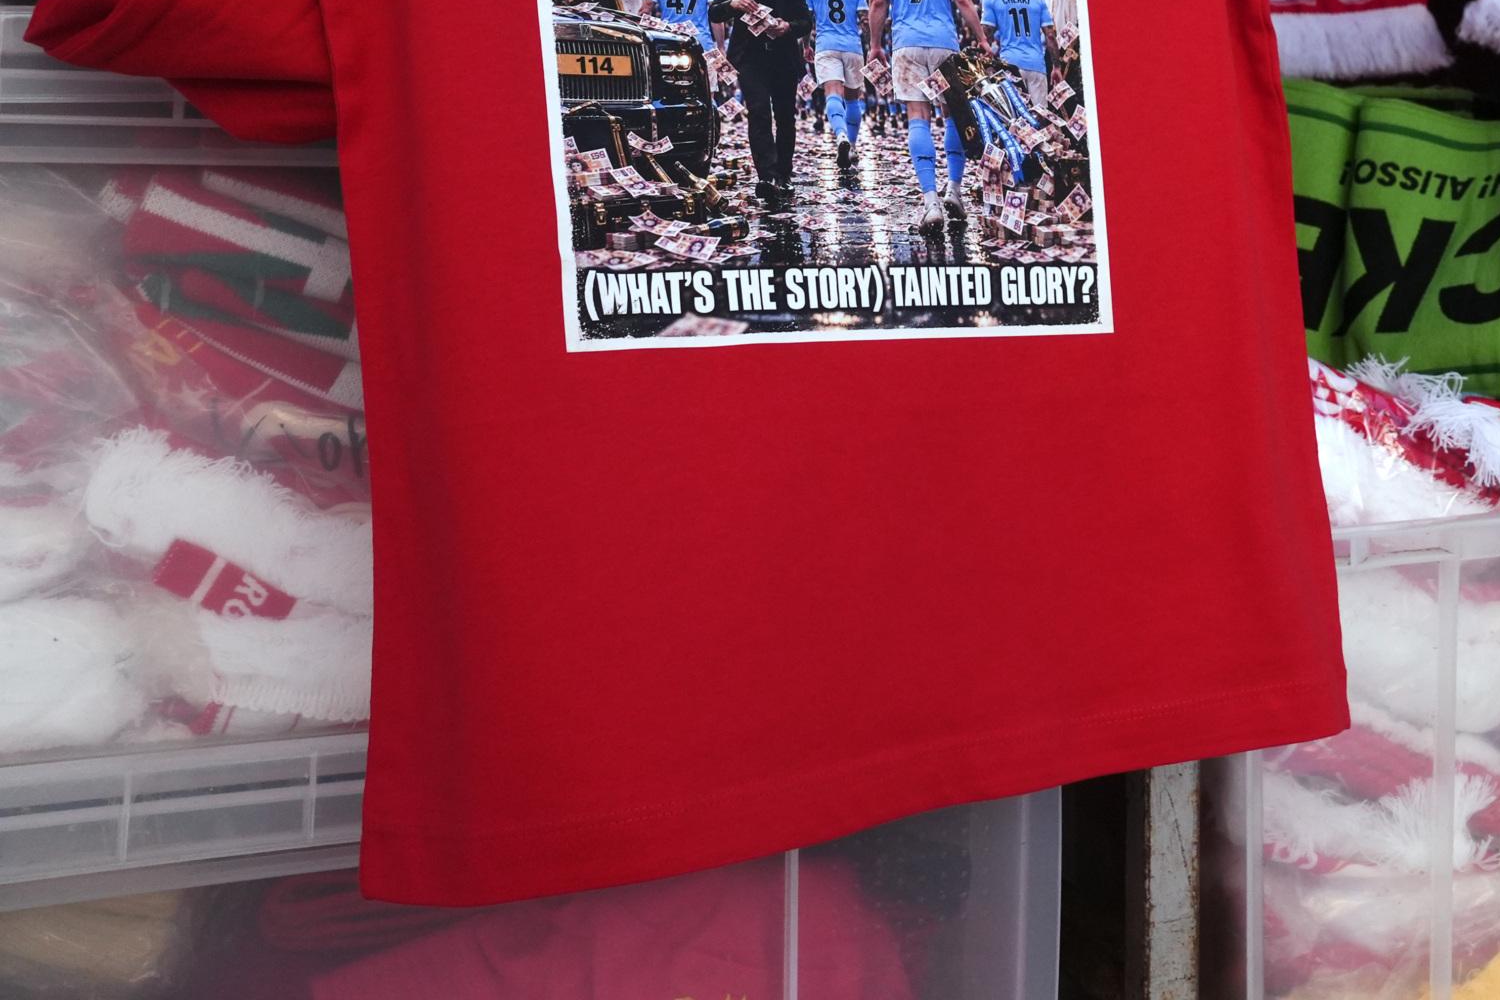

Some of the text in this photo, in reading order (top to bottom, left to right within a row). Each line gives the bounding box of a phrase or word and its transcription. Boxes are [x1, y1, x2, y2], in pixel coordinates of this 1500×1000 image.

[1008, 7, 1031, 38] 11
[576, 56, 614, 74] 114
[583, 264, 1093, 322] (WHAT'S THE STORY) TAINTED GLORY?
